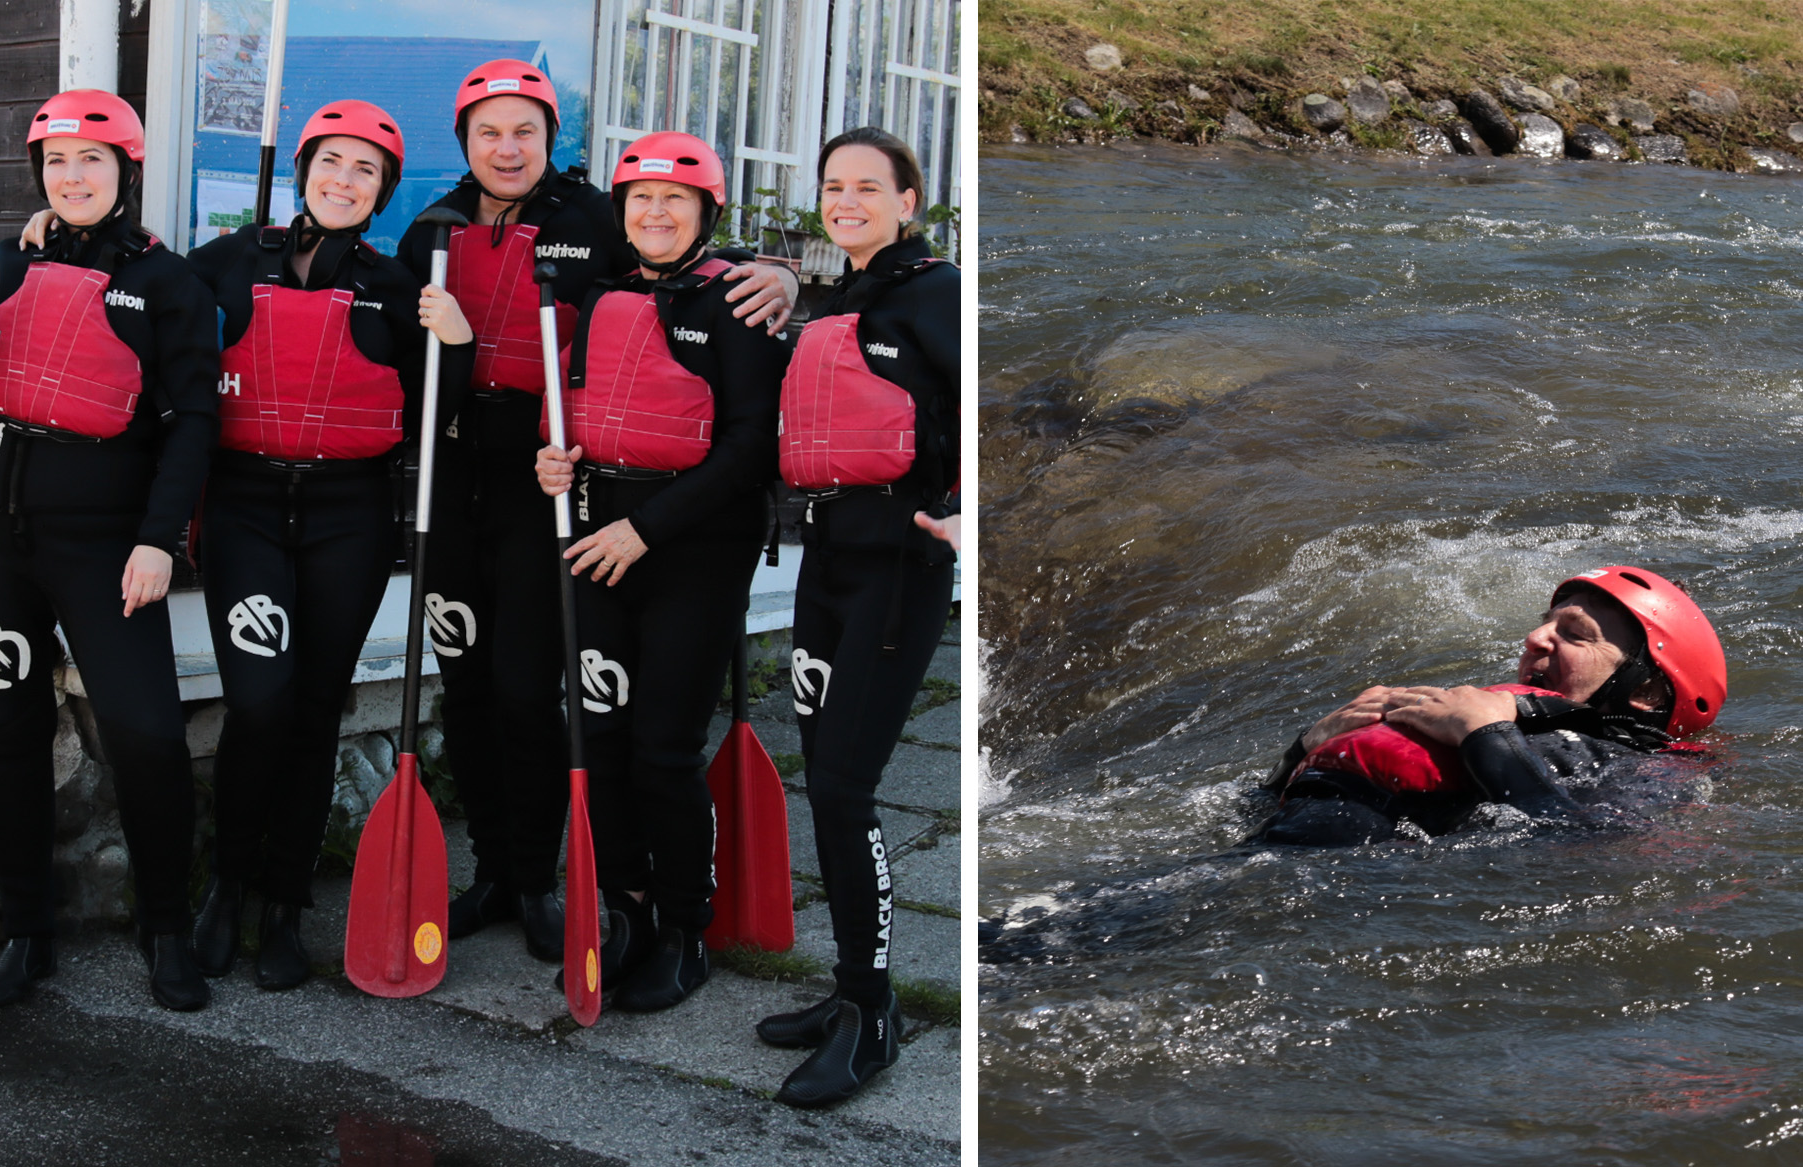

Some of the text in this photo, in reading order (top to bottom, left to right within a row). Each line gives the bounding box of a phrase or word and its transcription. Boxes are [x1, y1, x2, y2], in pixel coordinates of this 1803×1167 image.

[105, 288, 145, 311] TTON
[673, 326, 708, 344] TTON
[578, 471, 590, 522] BLAC
[867, 827, 893, 970] BLACK BROS
